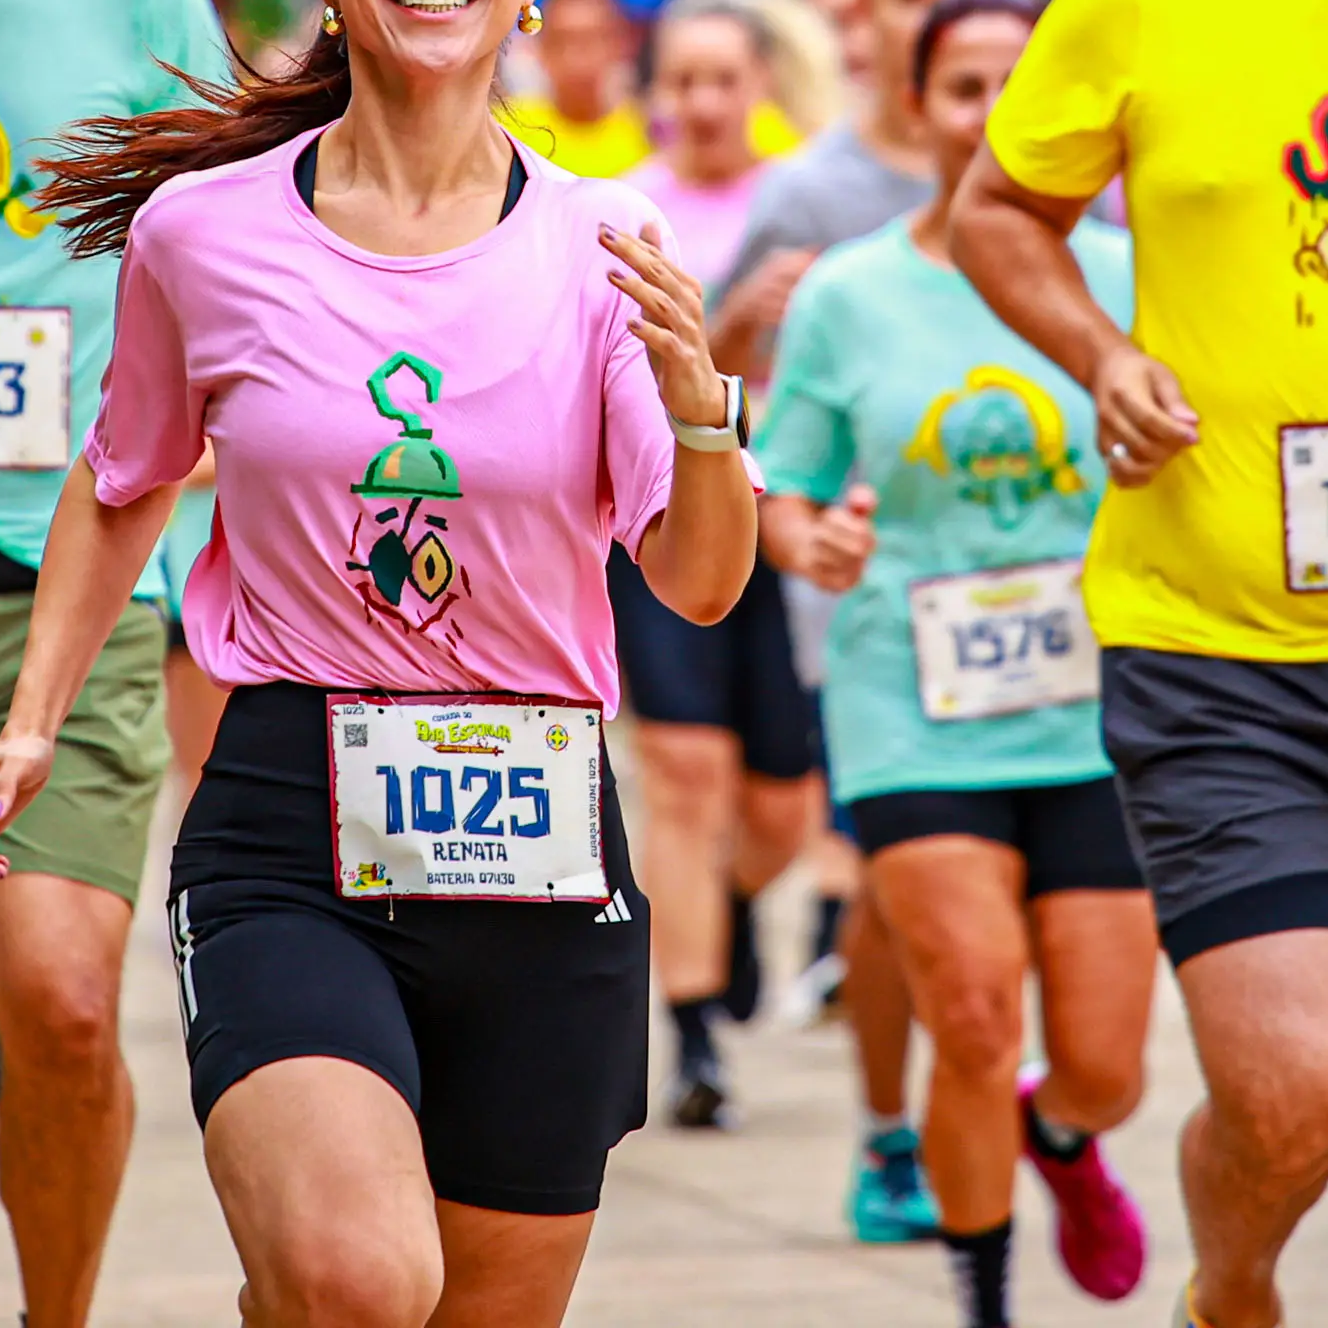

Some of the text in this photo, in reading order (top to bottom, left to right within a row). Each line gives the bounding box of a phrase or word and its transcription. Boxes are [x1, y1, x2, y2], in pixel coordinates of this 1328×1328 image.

[343, 704, 365, 715] 1025
[376, 765, 551, 838] 1025
[588, 758, 598, 858] GUARDA VOLUME 1025
[432, 841, 508, 862] RENATA
[427, 872, 515, 885] BATERIA 07H30
